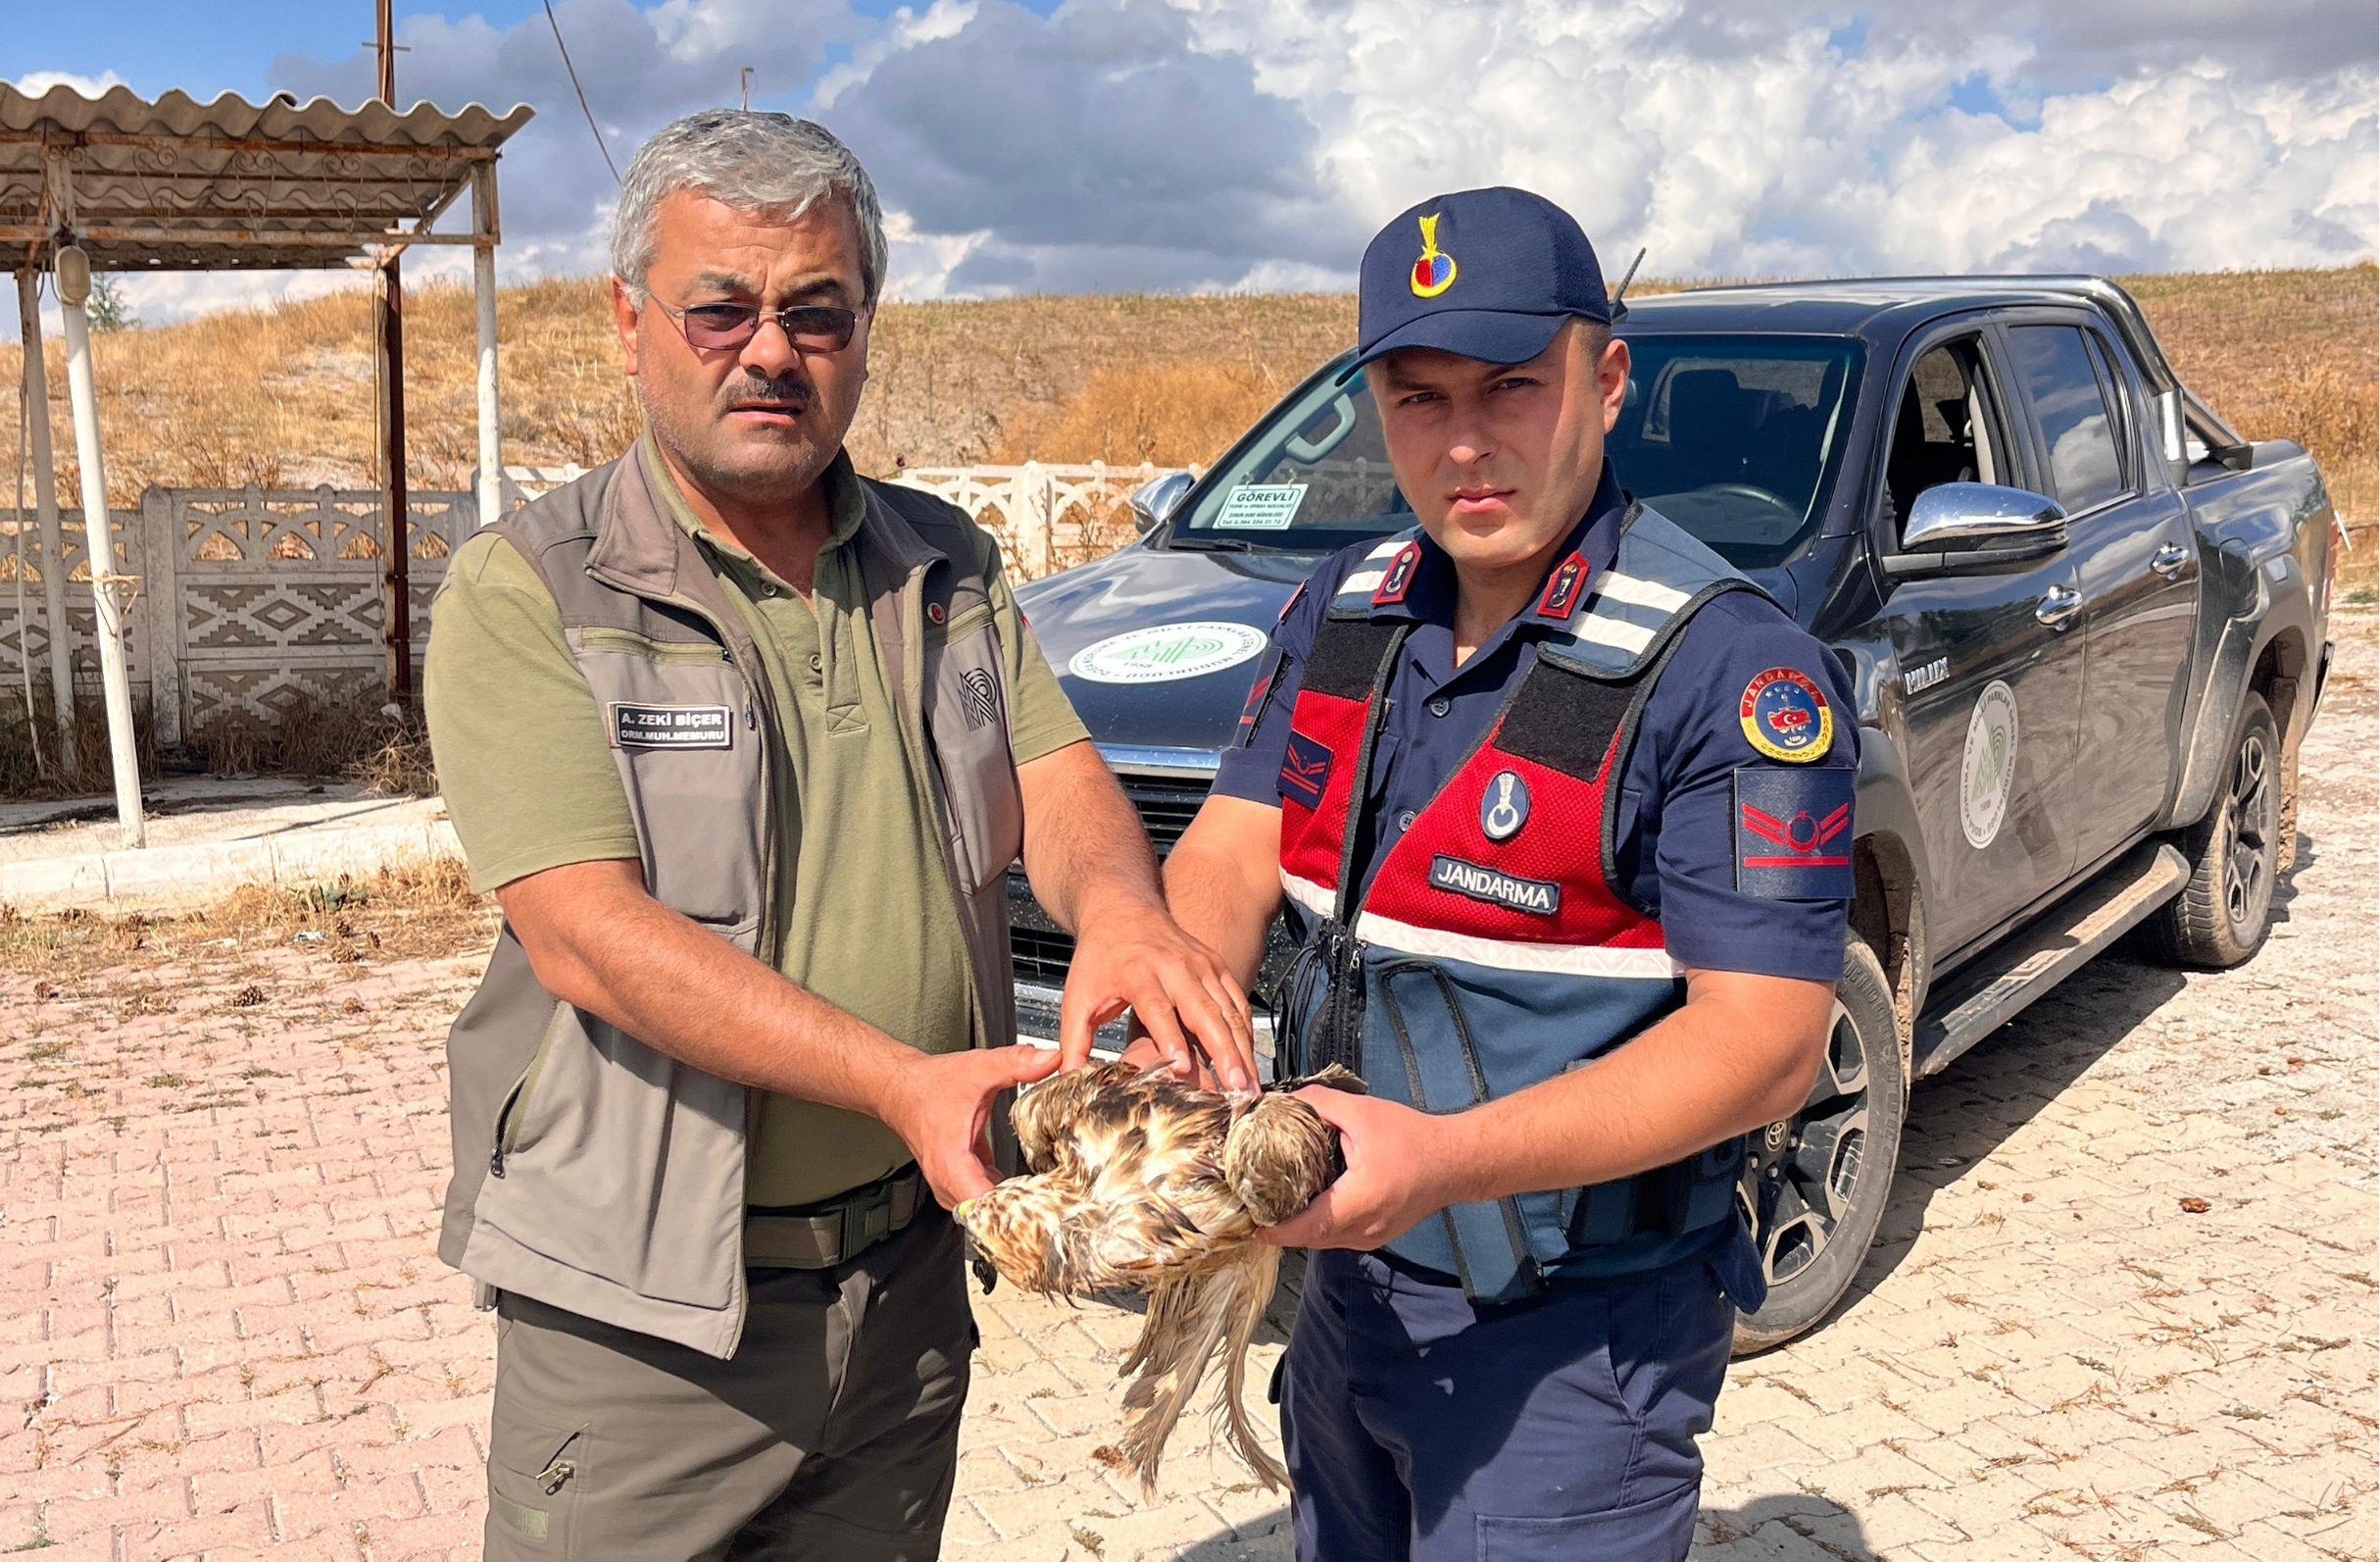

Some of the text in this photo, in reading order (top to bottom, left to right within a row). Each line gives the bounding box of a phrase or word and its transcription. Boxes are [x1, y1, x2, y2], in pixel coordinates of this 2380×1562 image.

[1236, 489, 1295, 502] GÖREVLİ
[621, 712, 722, 729] A. ZEKİ BİÇER
[620, 730, 724, 741] ORM.MUH.MEMURU
[1437, 863, 1550, 909] JANDARMA
